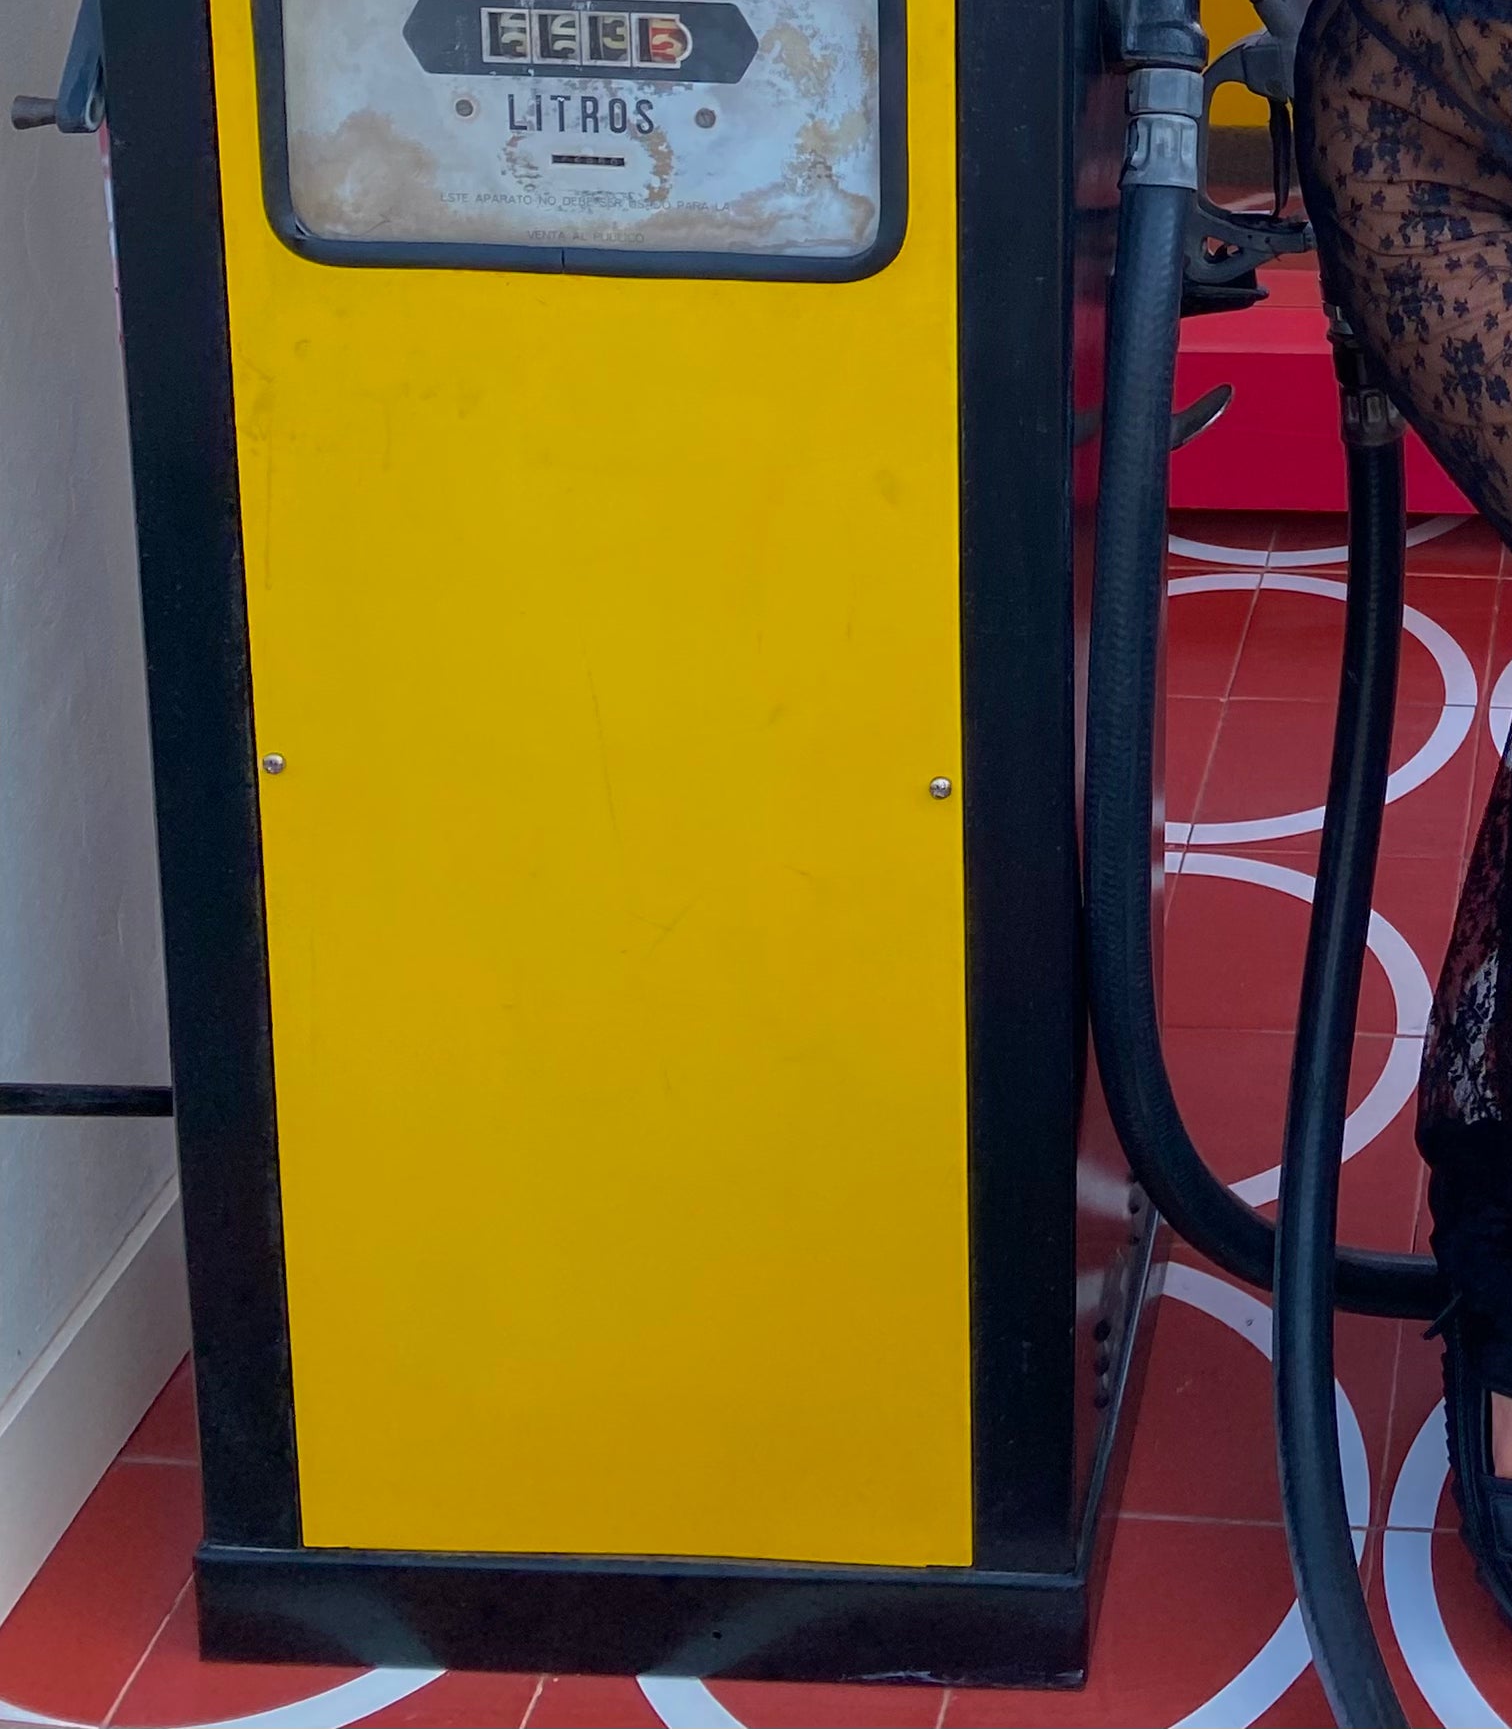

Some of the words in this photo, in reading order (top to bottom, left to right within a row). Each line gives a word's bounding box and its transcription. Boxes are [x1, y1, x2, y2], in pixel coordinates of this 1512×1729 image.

[507, 93, 655, 135] LITROS
[475, 193, 532, 206] APARATO
[538, 195, 557, 207] NO
[677, 200, 709, 211] PARA
[715, 201, 731, 212] LA
